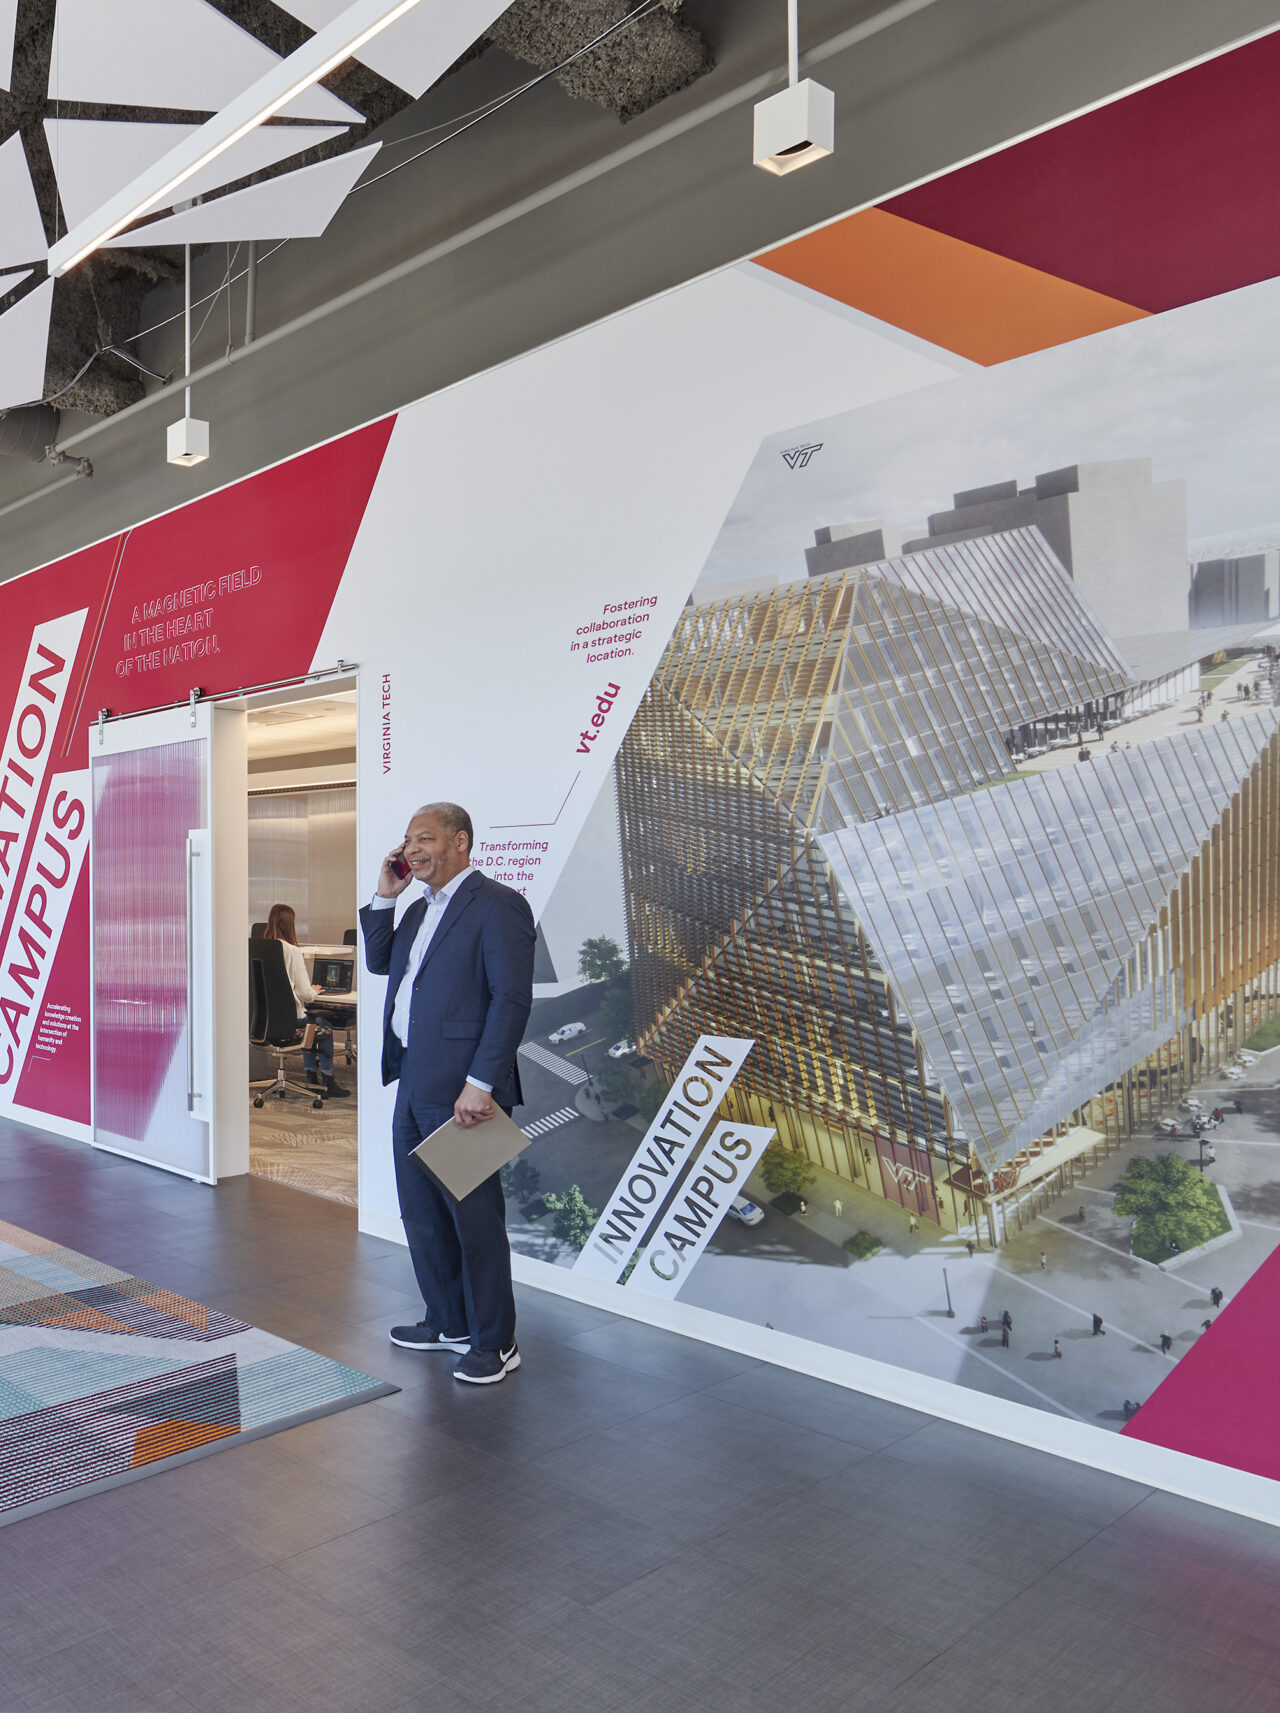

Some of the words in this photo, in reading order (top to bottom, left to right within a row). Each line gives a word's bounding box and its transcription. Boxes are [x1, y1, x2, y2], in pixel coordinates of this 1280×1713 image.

[782, 443, 823, 469] VT
[132, 606, 141, 624] A
[143, 580, 216, 621] MAGNETIC
[219, 565, 262, 596] FIELD
[603, 596, 658, 615] Fostering
[123, 632, 137, 651] IN
[139, 624, 164, 647] THE
[167, 608, 214, 639] HEART
[576, 613, 650, 635] collaboration
[570, 641, 580, 651] in
[582, 641, 589, 649] a
[591, 629, 642, 647] strategic
[116, 657, 134, 677] OF
[135, 650, 161, 673] THE
[163, 634, 220, 665] NATION.
[586, 648, 634, 663] location.
[382, 673, 391, 709] TECH
[576, 682, 621, 754] vt.edu
[382, 711, 391, 775] VIRGINIA
[480, 840, 549, 852] Transforming
[486, 856, 506, 866] D.C.
[508, 855, 542, 868] region
[493, 871, 514, 881] into
[517, 870, 534, 881] the
[44, 1010, 65, 1020] knowledge
[46, 1002, 71, 1013] Accelerating
[592, 1045, 733, 1265] INNOVATION
[649, 1131, 752, 1281] CAMPUS
